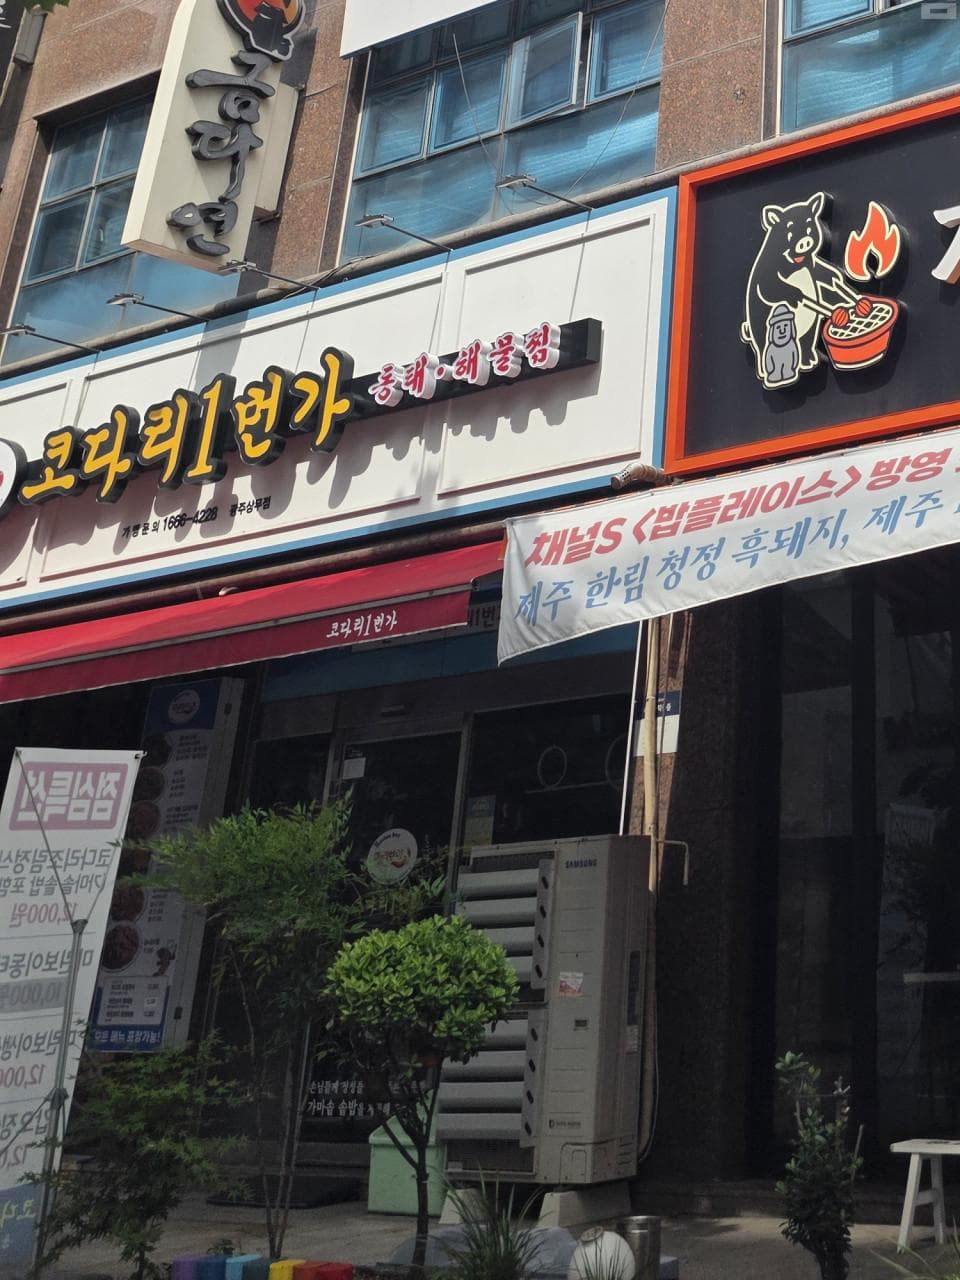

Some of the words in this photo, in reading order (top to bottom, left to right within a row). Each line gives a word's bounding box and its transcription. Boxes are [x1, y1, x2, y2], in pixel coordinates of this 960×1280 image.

[21, 350, 352, 500] 코다리1번가
[514, 578, 572, 627] 제주
[586, 557, 650, 610] 한림
[660, 536, 725, 593] 청정
[863, 488, 945, 537] 제주
[524, 517, 624, 567] 채널S
[865, 448, 951, 491] 방영
[326, 609, 398, 639] 코다리1번가
